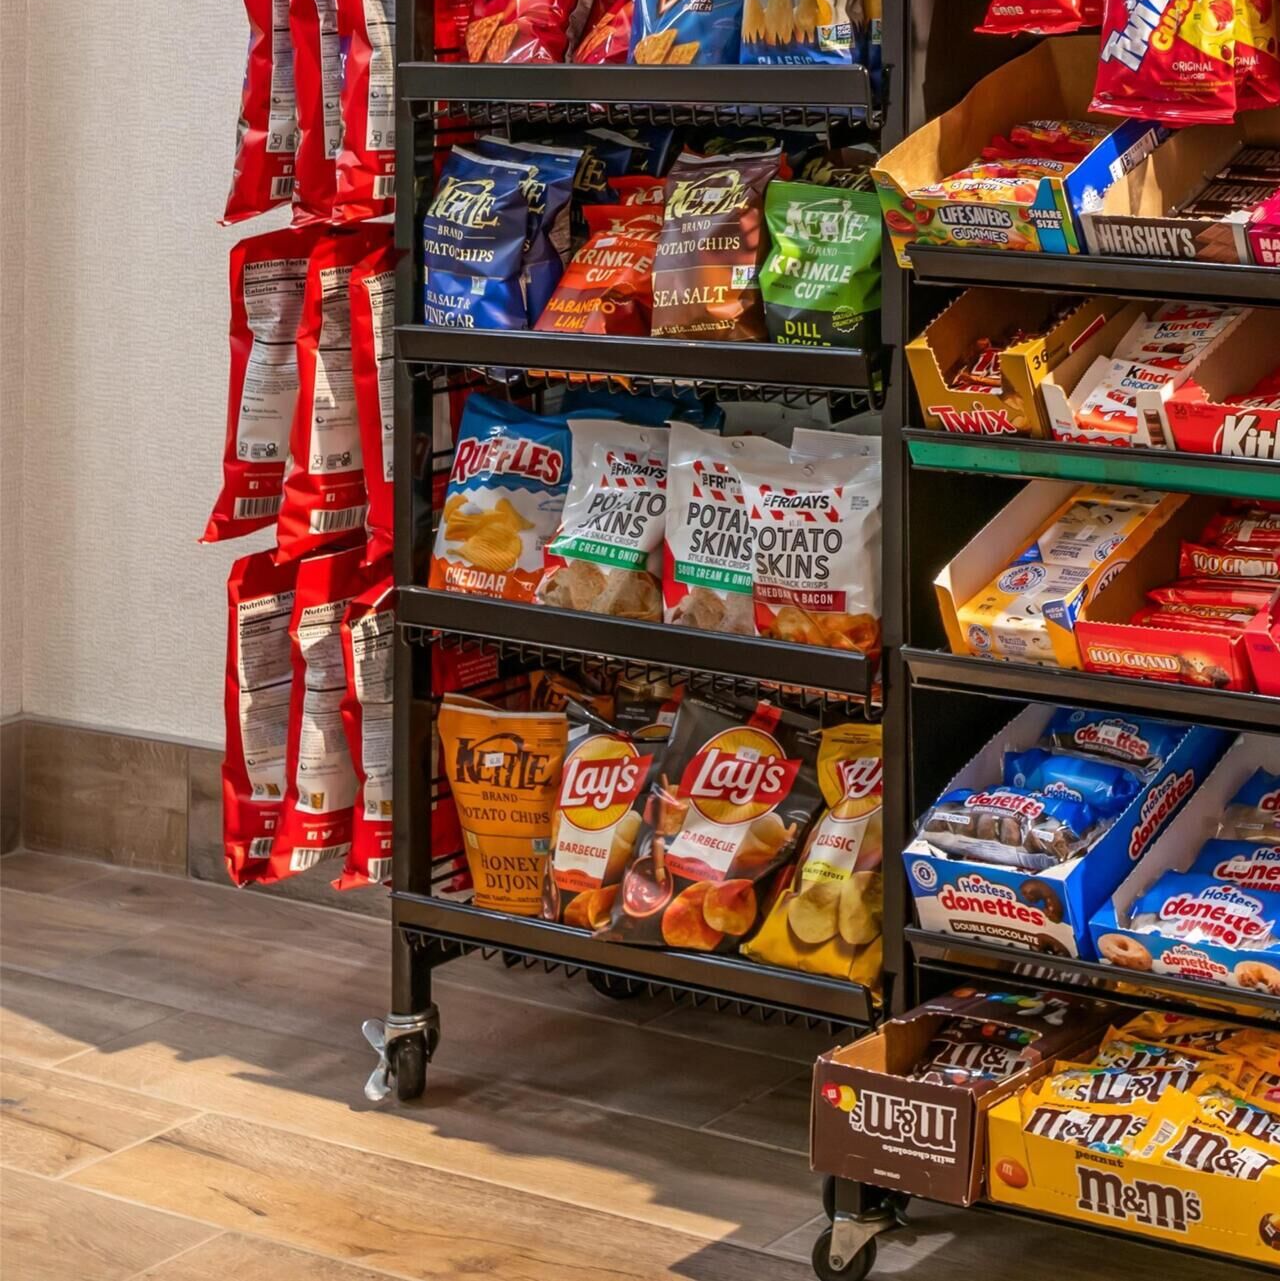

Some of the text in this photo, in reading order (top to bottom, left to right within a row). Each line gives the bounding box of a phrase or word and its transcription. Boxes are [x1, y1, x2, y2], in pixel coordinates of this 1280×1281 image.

[1172, 61, 1213, 71] ORIGINAL
[1029, 209, 1063, 220] SHARE
[438, 226, 463, 239] BRAND
[681, 221, 711, 233] BRAND
[1037, 220, 1060, 230] SIZE
[952, 228, 1007, 242] GUMMIES
[656, 236, 740, 256] POTATO CHIPS
[455, 247, 495, 263] CHIPS
[572, 249, 652, 273] KRINKLE
[586, 268, 615, 282] CUT
[769, 256, 850, 283] KRINKLE
[653, 286, 728, 307] SEA SALT
[795, 283, 824, 299] CUT
[785, 321, 821, 338] DILL
[616, 463, 666, 479] FRIDAYS
[770, 495, 829, 510] FRIDAYS
[756, 552, 829, 579] SKINS
[445, 567, 507, 591] CHEDDAR
[801, 592, 833, 604] BACON
[1089, 648, 1178, 671] 100 GRAND
[559, 757, 638, 808] Lay's
[691, 749, 784, 804] Lay's
[481, 791, 518, 803] BRAND
[510, 809, 550, 823] CHIPS
[559, 841, 607, 858] BARBECUE
[684, 829, 736, 853] BARBECUE
[817, 834, 855, 851] CLASSIC
[481, 854, 540, 872] HONEY
[486, 872, 539, 889] DIJON
[962, 879, 1013, 901] Hostess
[941, 890, 1045, 927] donettes
[1076, 1149, 1123, 1168] peanut
